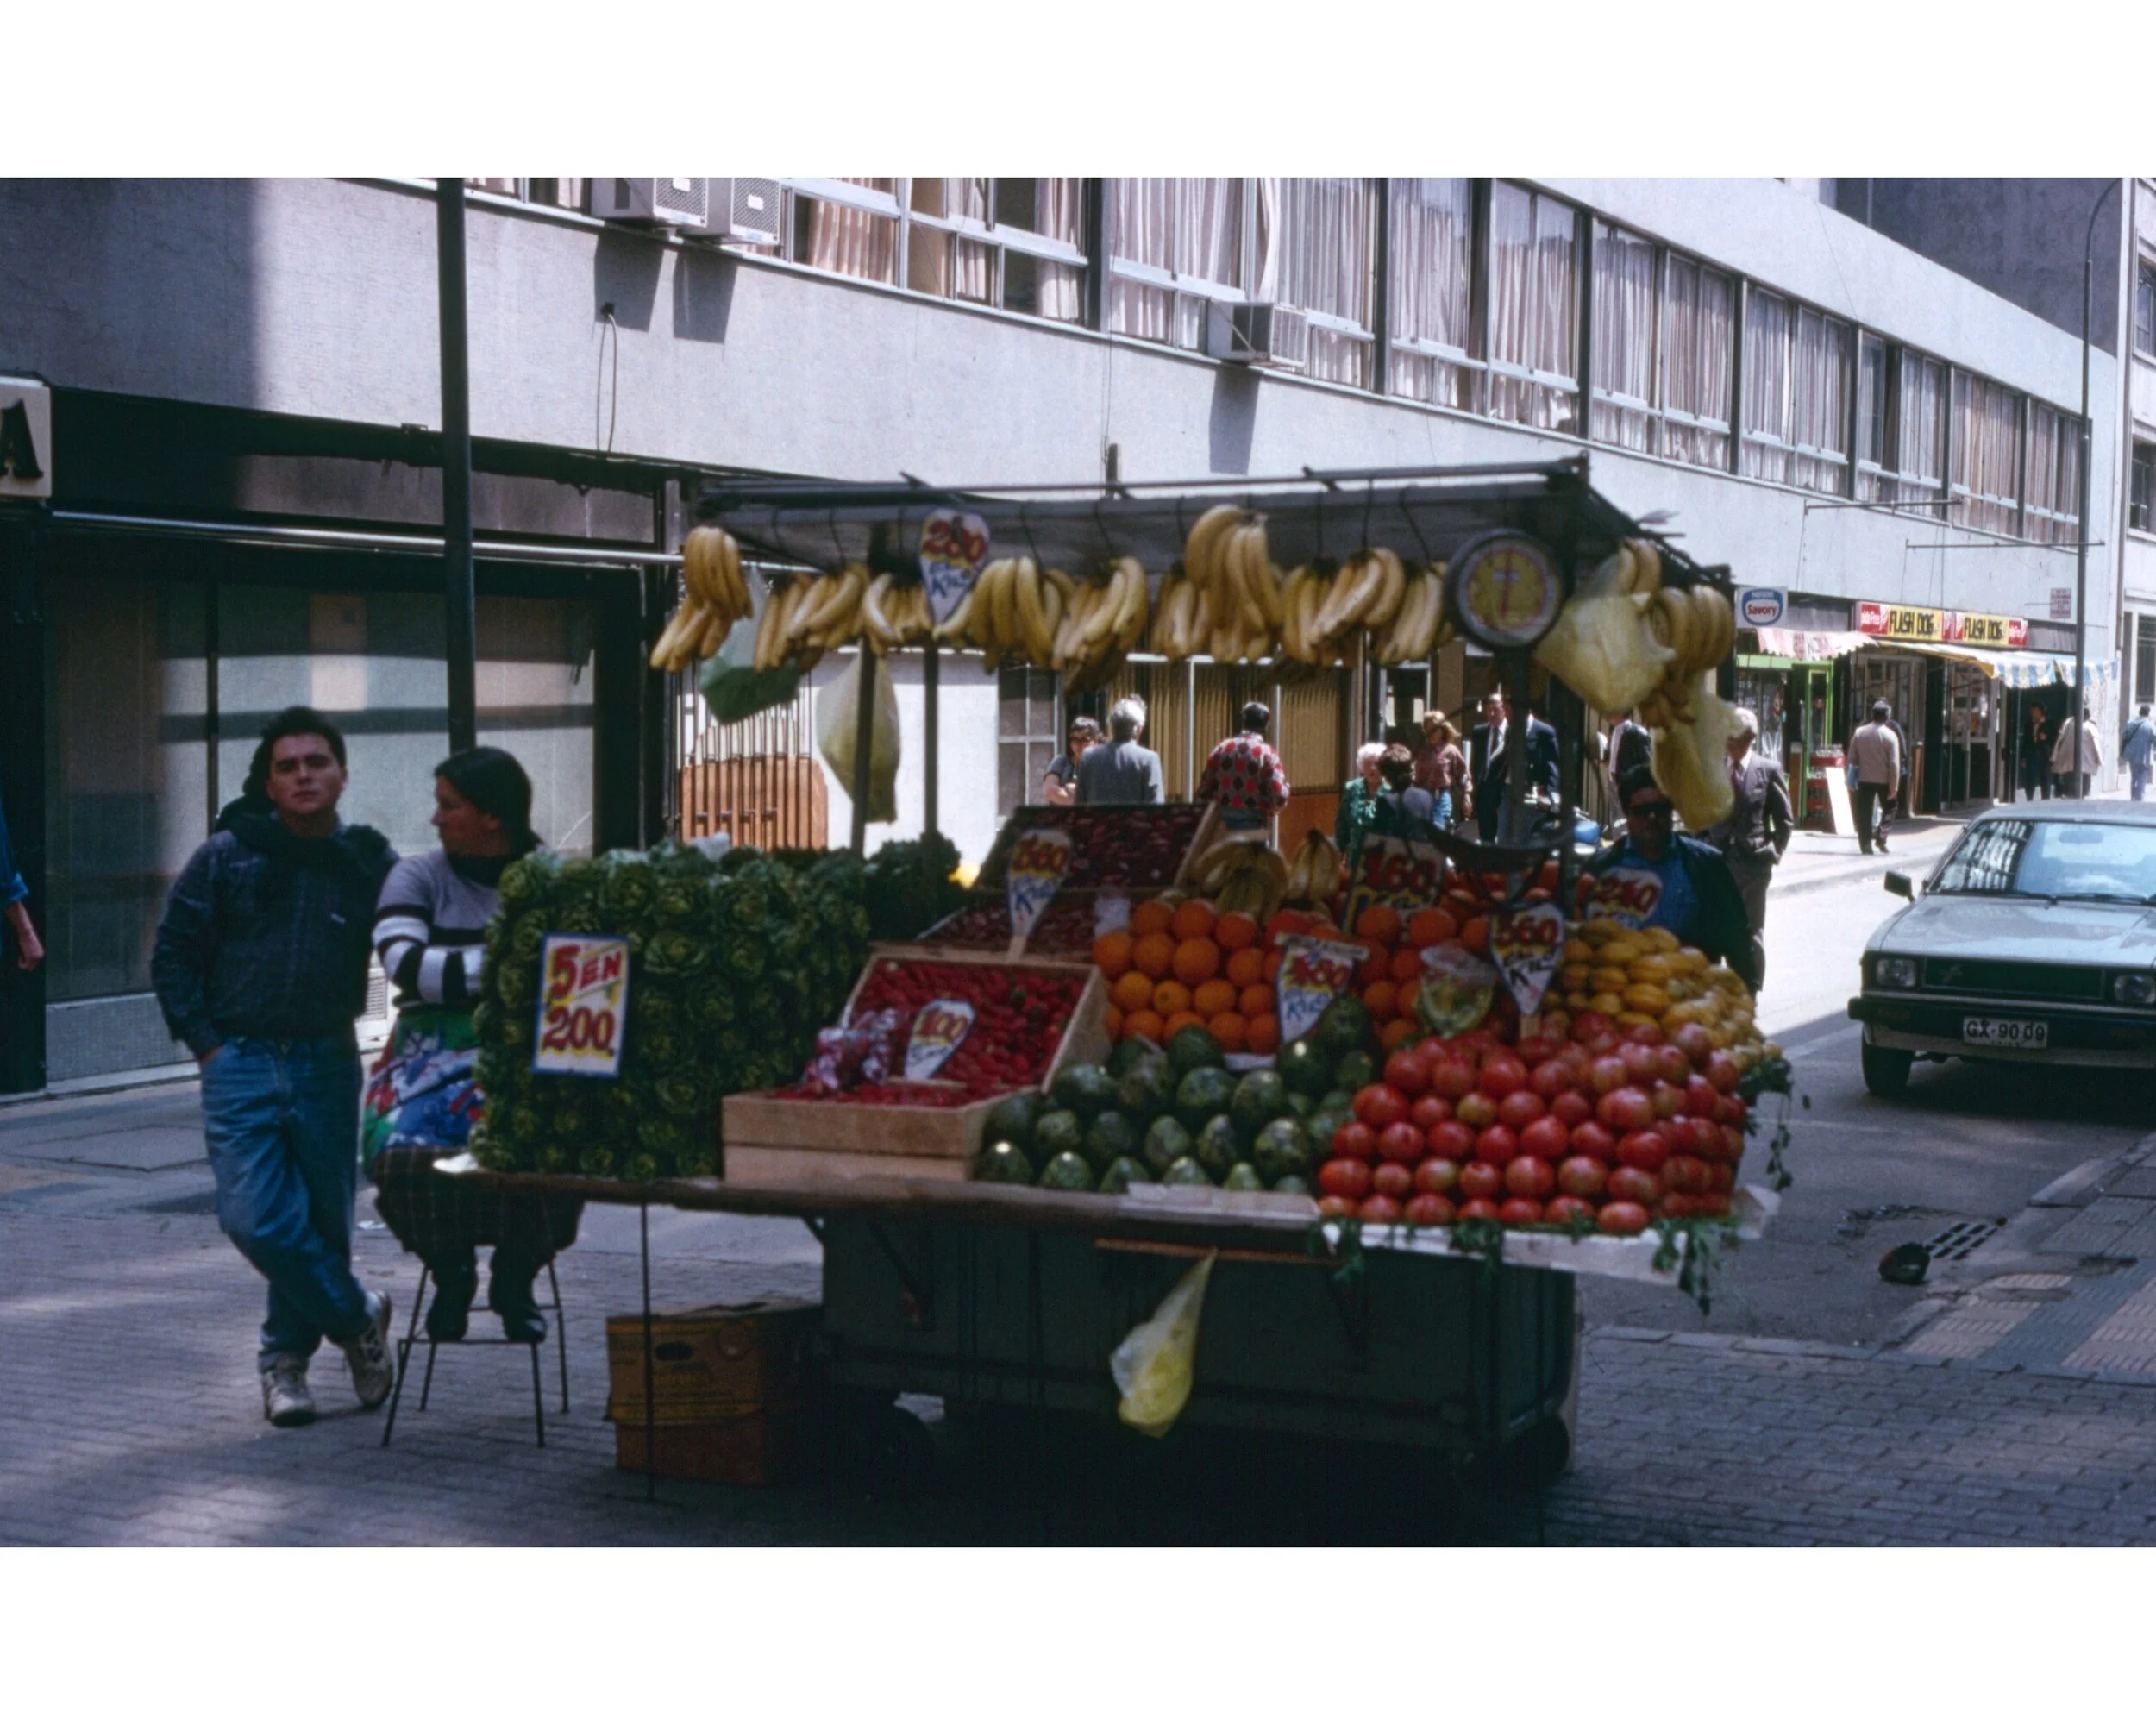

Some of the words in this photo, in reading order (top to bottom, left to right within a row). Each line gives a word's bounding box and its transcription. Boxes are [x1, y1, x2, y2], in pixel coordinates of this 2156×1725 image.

[1747, 604, 1777, 617] Savory
[1890, 610, 1915, 634] FLASH
[1964, 617, 1986, 640] FLASH
[549, 944, 580, 998] 5
[579, 950, 623, 990] EN
[542, 1006, 615, 1054] 200
